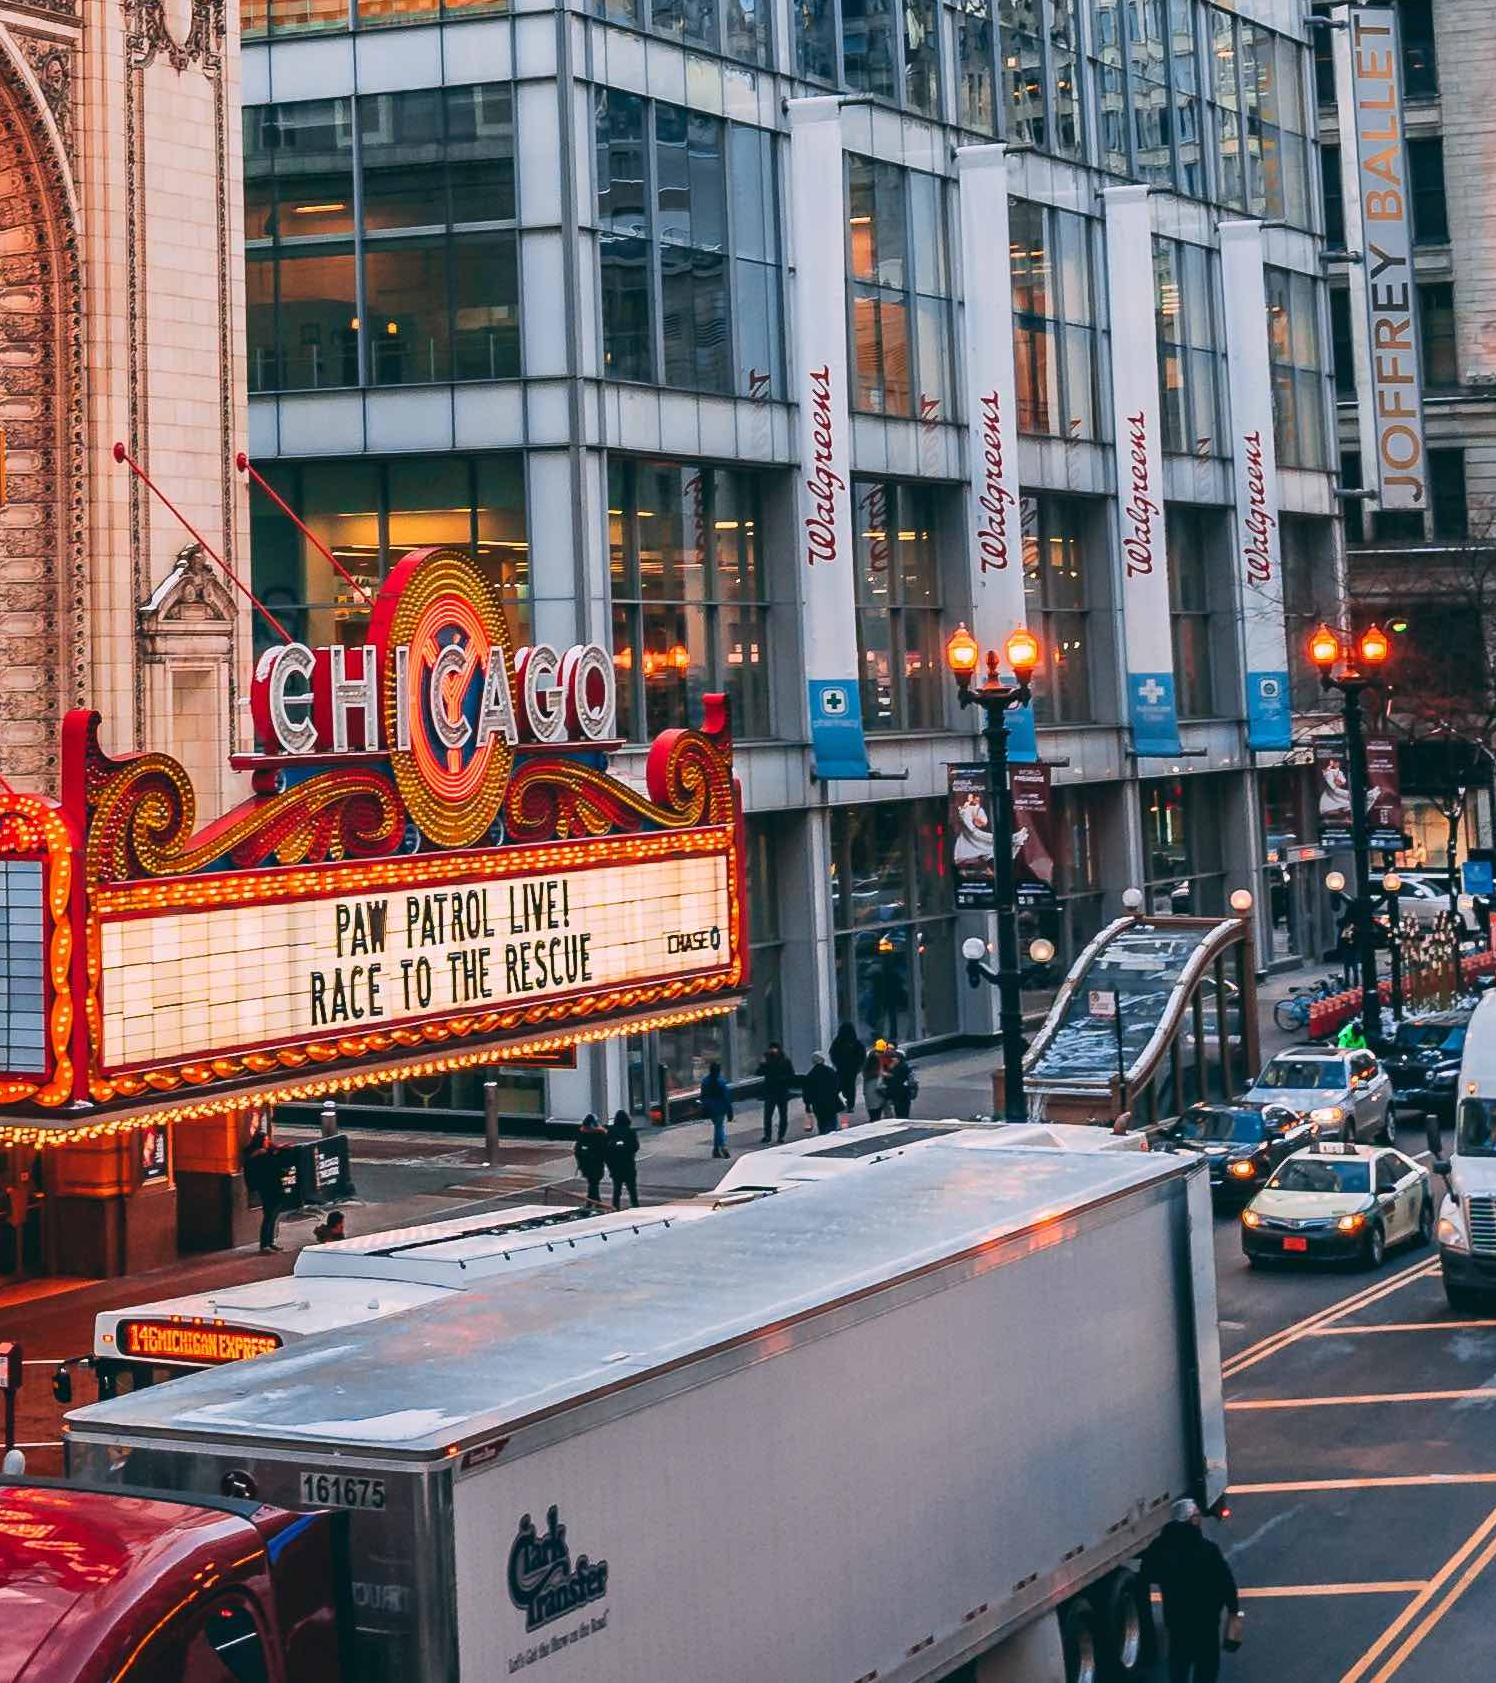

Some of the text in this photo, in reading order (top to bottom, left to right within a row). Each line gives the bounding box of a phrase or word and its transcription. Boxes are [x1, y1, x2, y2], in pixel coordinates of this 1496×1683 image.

[1355, 14, 1422, 504] JOFFREY BALLET
[806, 365, 844, 566] Walgreens
[977, 390, 1015, 573] Walgreens
[1123, 411, 1159, 577] Walgreens
[1243, 431, 1276, 586] Walgreens
[267, 641, 617, 756] CHICAGO
[336, 879, 571, 958] PAW PATROL LIVE!
[667, 930, 709, 955] CHASE
[311, 932, 593, 1027] RACE TO THE RESCUE
[158, 1327, 217, 1359] MICHIGAN
[302, 1473, 386, 1509] 161675
[525, 1555, 609, 1633] Transfer
